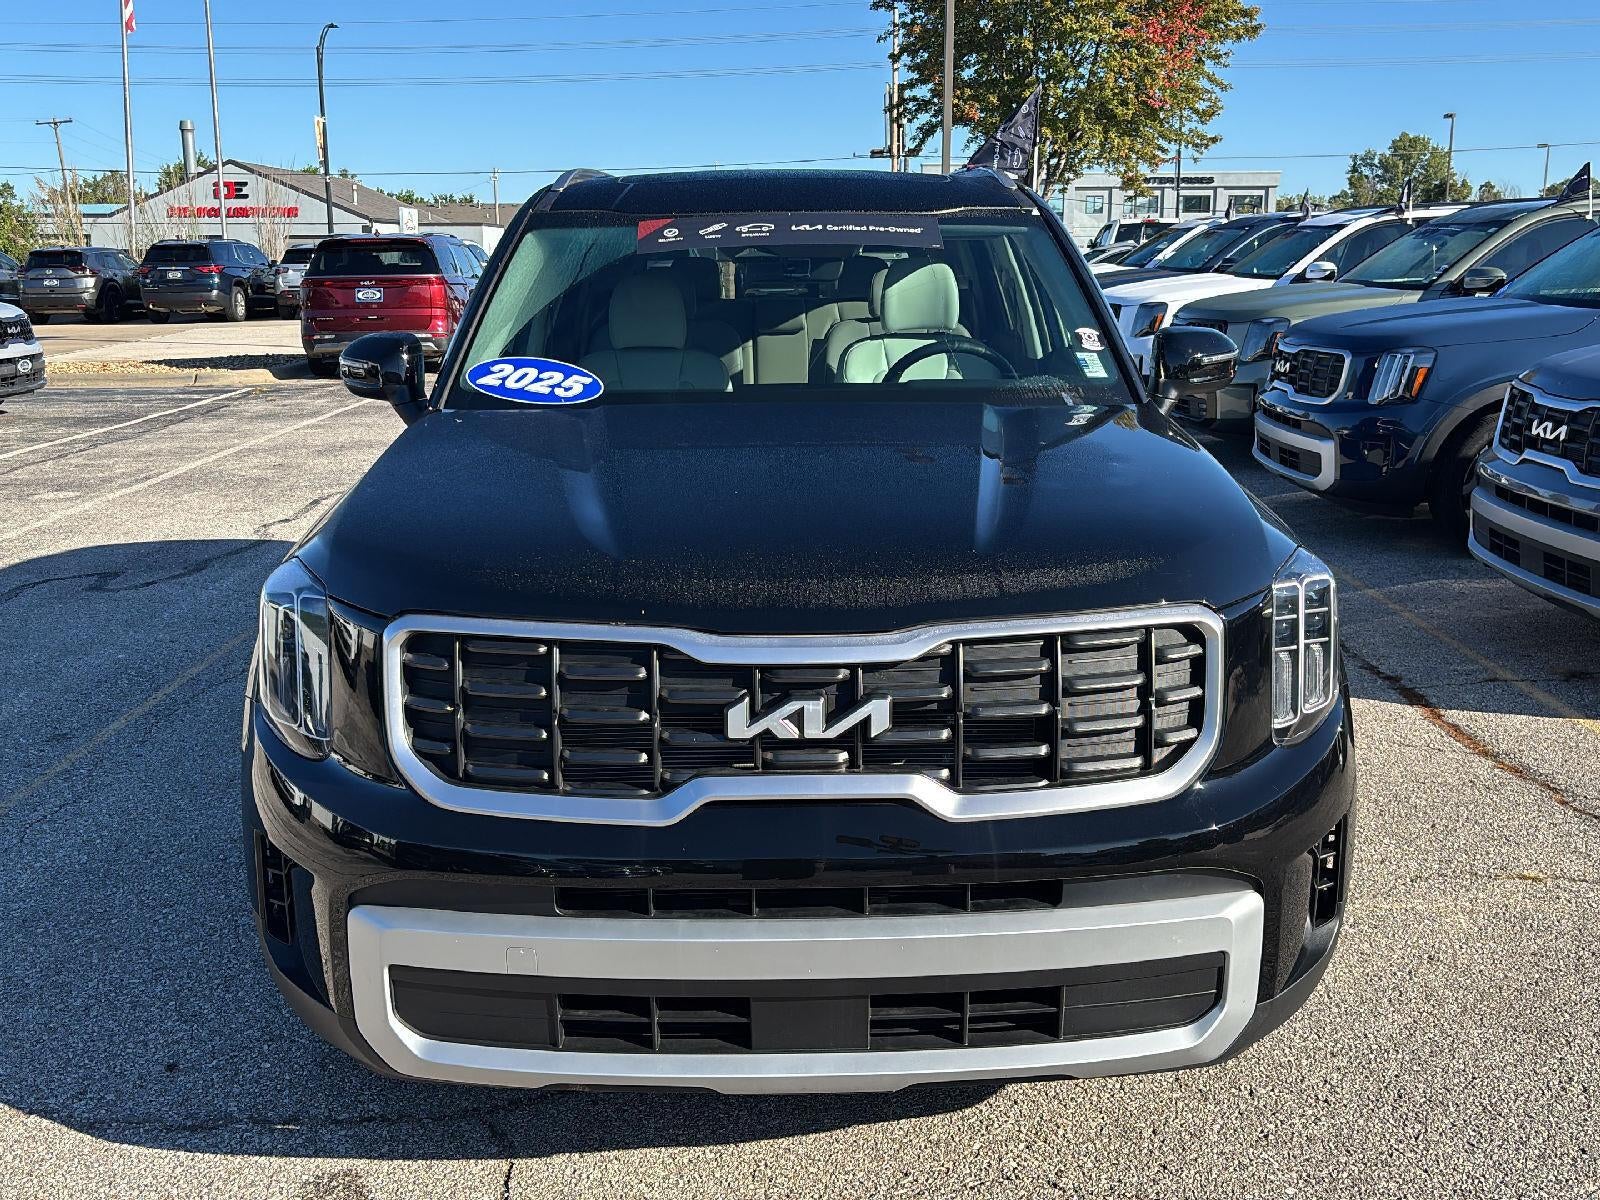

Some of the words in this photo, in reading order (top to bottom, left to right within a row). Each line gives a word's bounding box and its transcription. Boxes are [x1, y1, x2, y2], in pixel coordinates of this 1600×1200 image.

[826, 224, 867, 232] Certified
[1275, 357, 1291, 374] KIA
[476, 363, 593, 398] 2025
[1531, 418, 1568, 442] KIA
[726, 691, 892, 740] KIA
